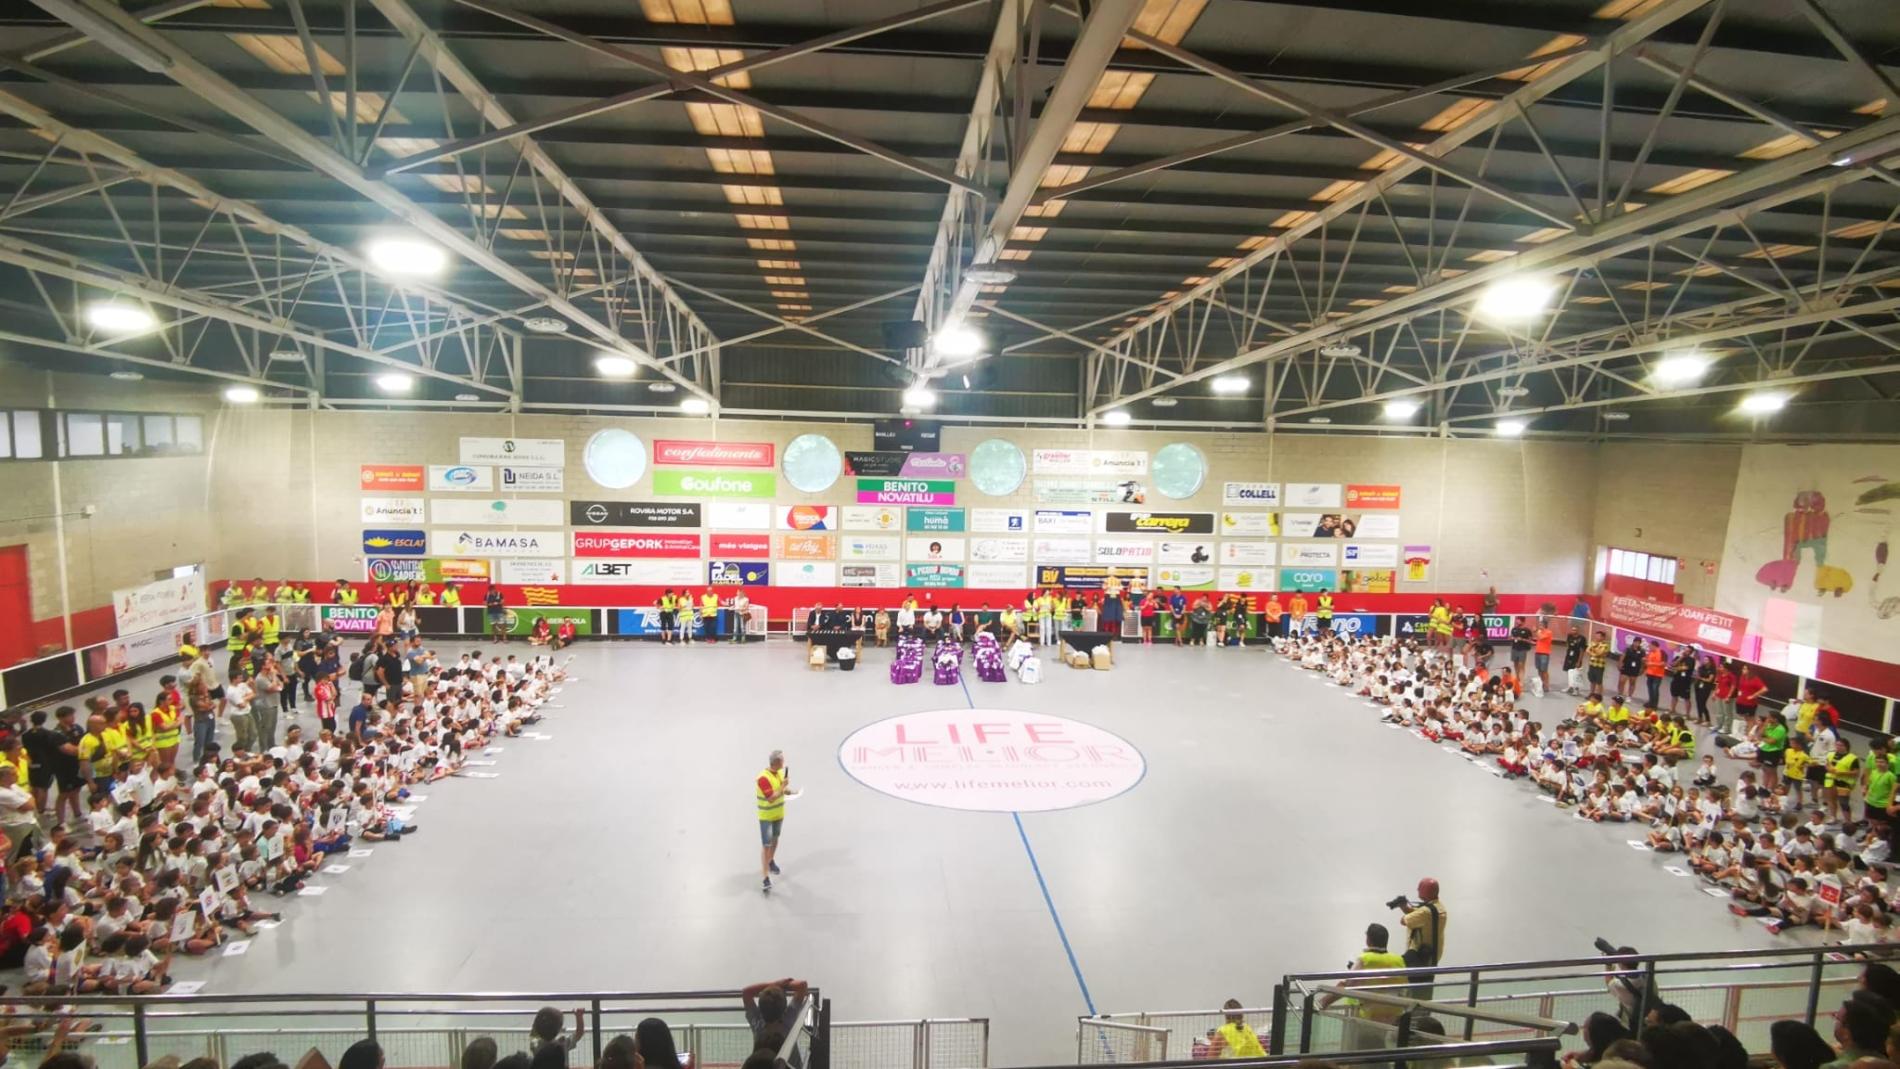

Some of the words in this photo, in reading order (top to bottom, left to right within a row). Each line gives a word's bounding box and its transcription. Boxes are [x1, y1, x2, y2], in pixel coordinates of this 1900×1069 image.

[664, 446, 763, 461] confidiments
[681, 476, 752, 492] Goufone
[883, 481, 928, 492] BENITO
[878, 492, 934, 503] NOVATILU
[1239, 489, 1276, 499] COLLELL
[475, 537, 539, 548] BAMASA
[581, 563, 632, 575] ALBET
[329, 607, 378, 619] BENITO
[333, 619, 377, 630] OVATIL
[1704, 613, 1733, 628] PETIT
[895, 722, 1075, 745] LIFE
[894, 778, 1112, 790] www.lifemelior.com
